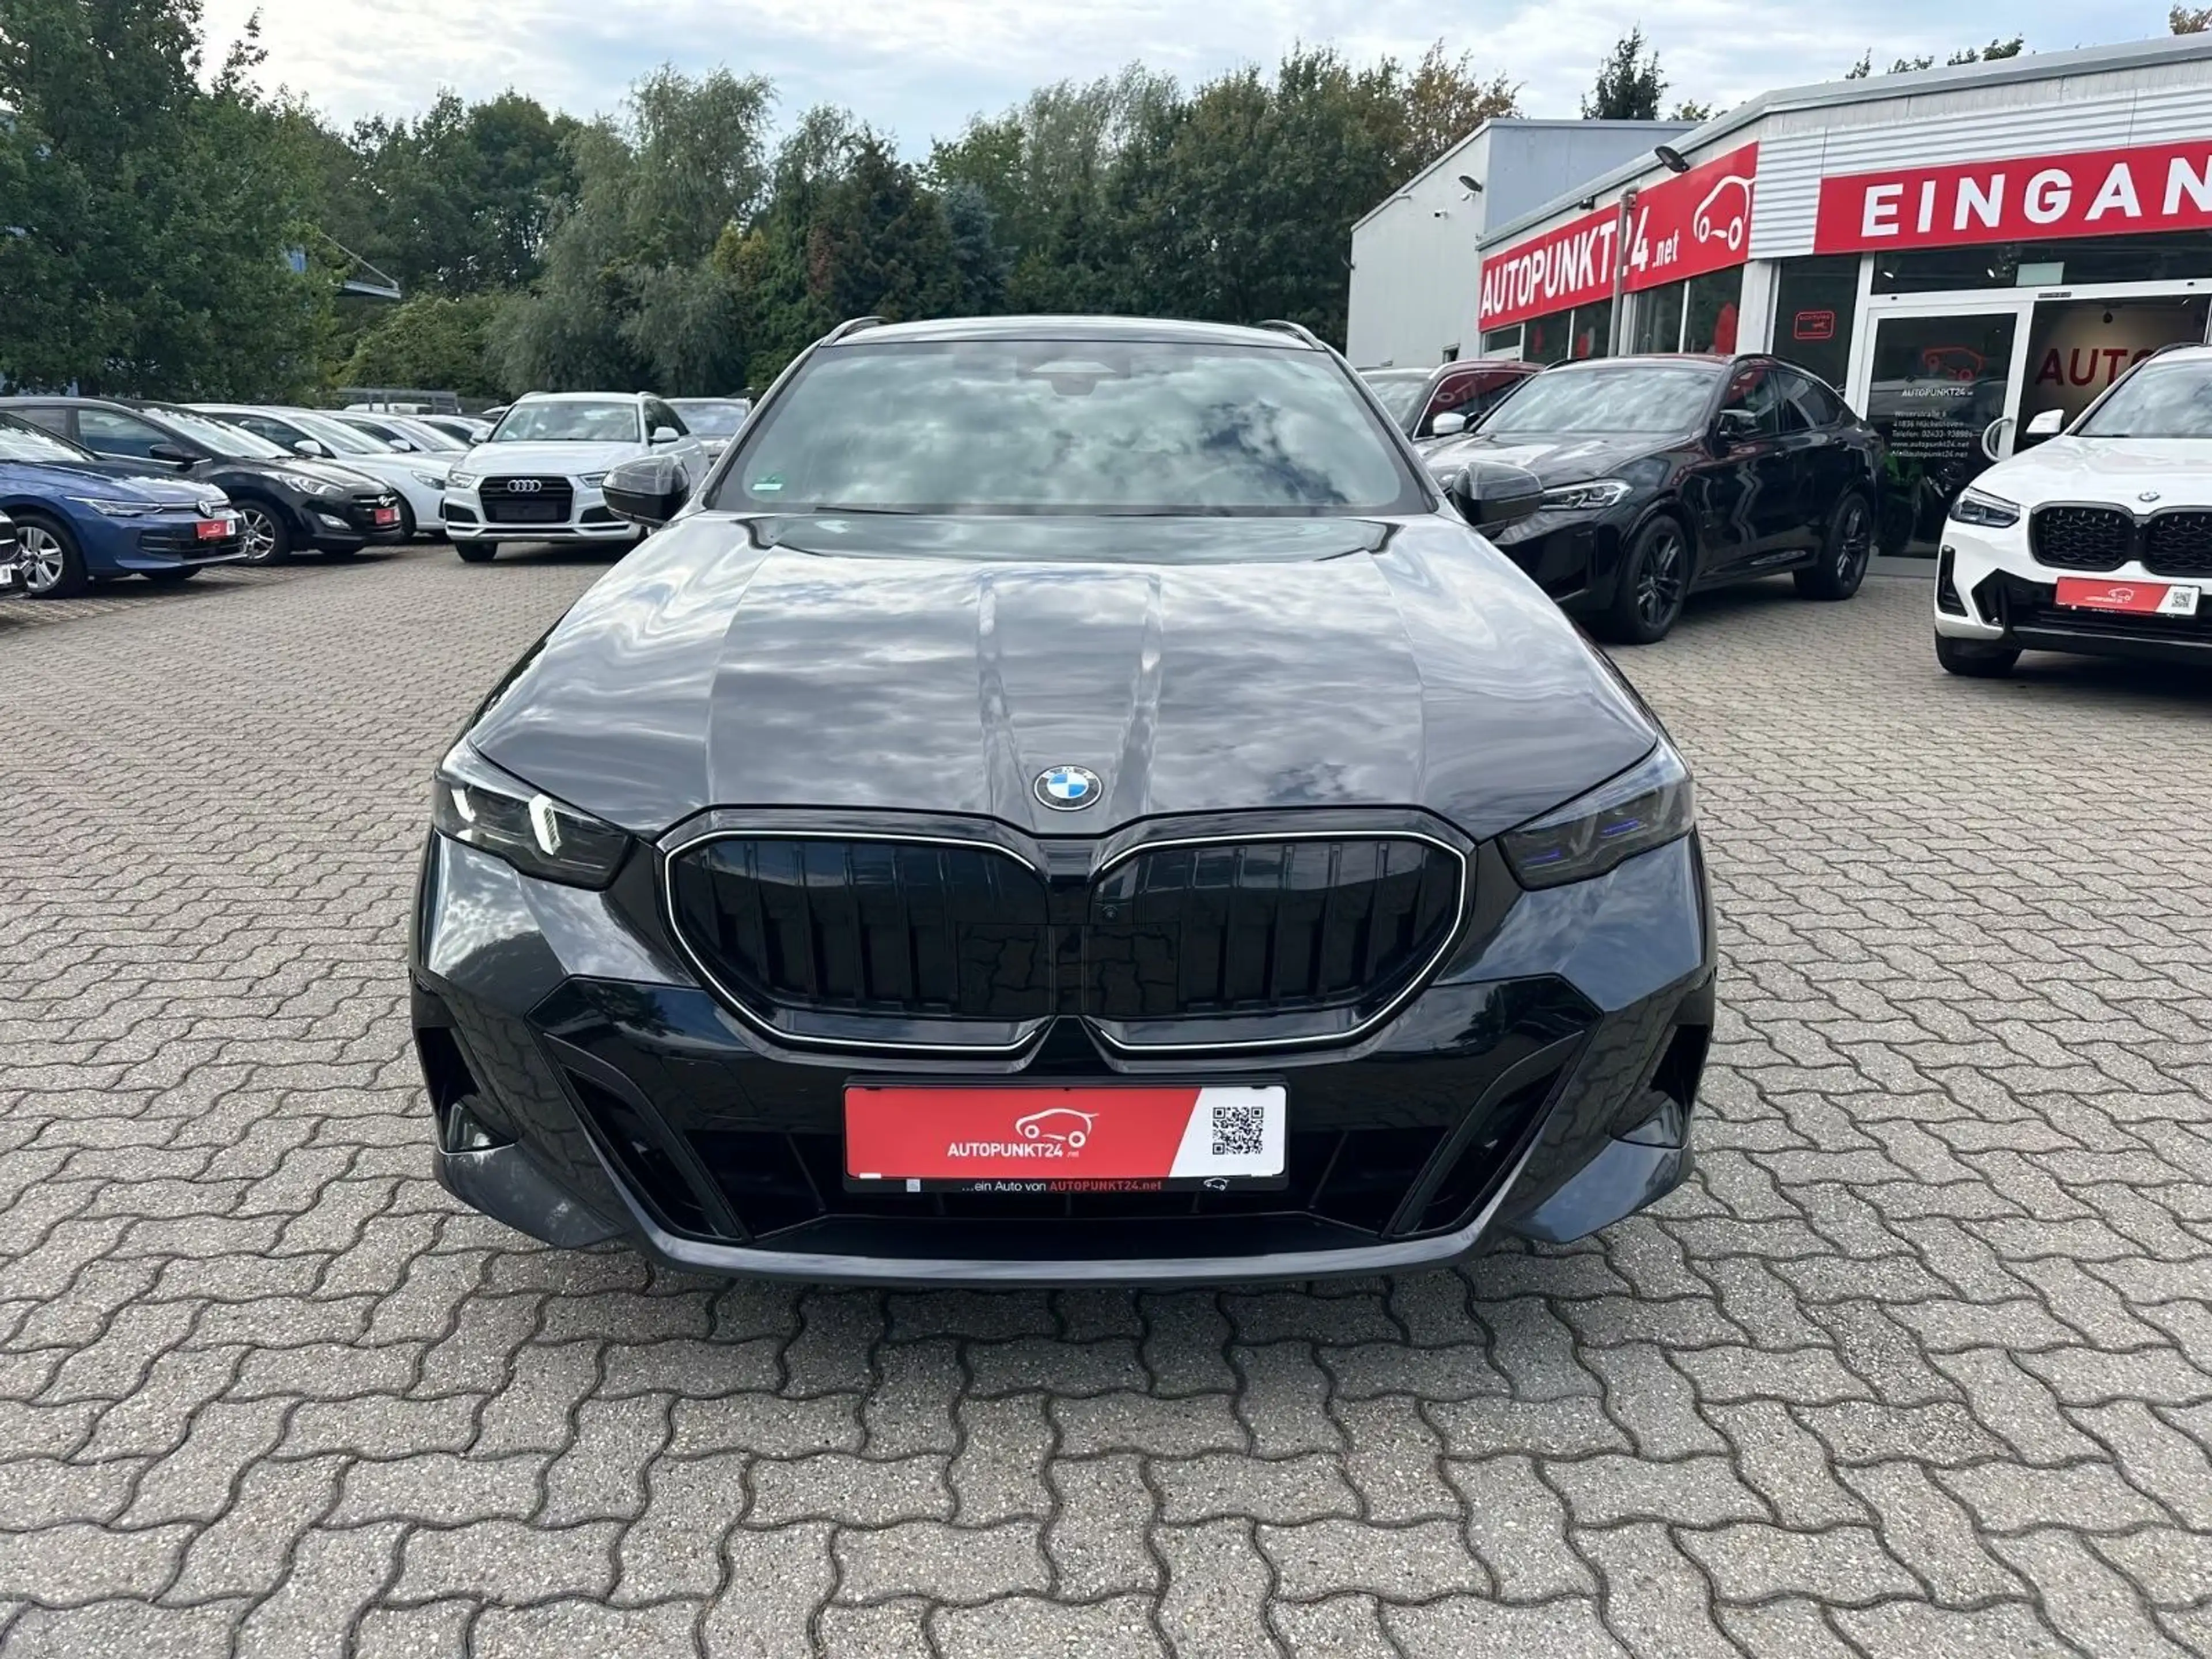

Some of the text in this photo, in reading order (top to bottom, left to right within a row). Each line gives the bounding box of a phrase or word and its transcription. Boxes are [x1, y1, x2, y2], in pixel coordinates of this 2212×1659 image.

[1652, 229, 1679, 268] .net
[1902, 387, 1965, 397] AUTOPUNKT24
[947, 1143, 1063, 1158] AUTOPUNKT24
[995, 1181, 1022, 1192] Auto
[1025, 1183, 1046, 1192] von
[1050, 1181, 1161, 1191] AUTOPUNKT24.net
